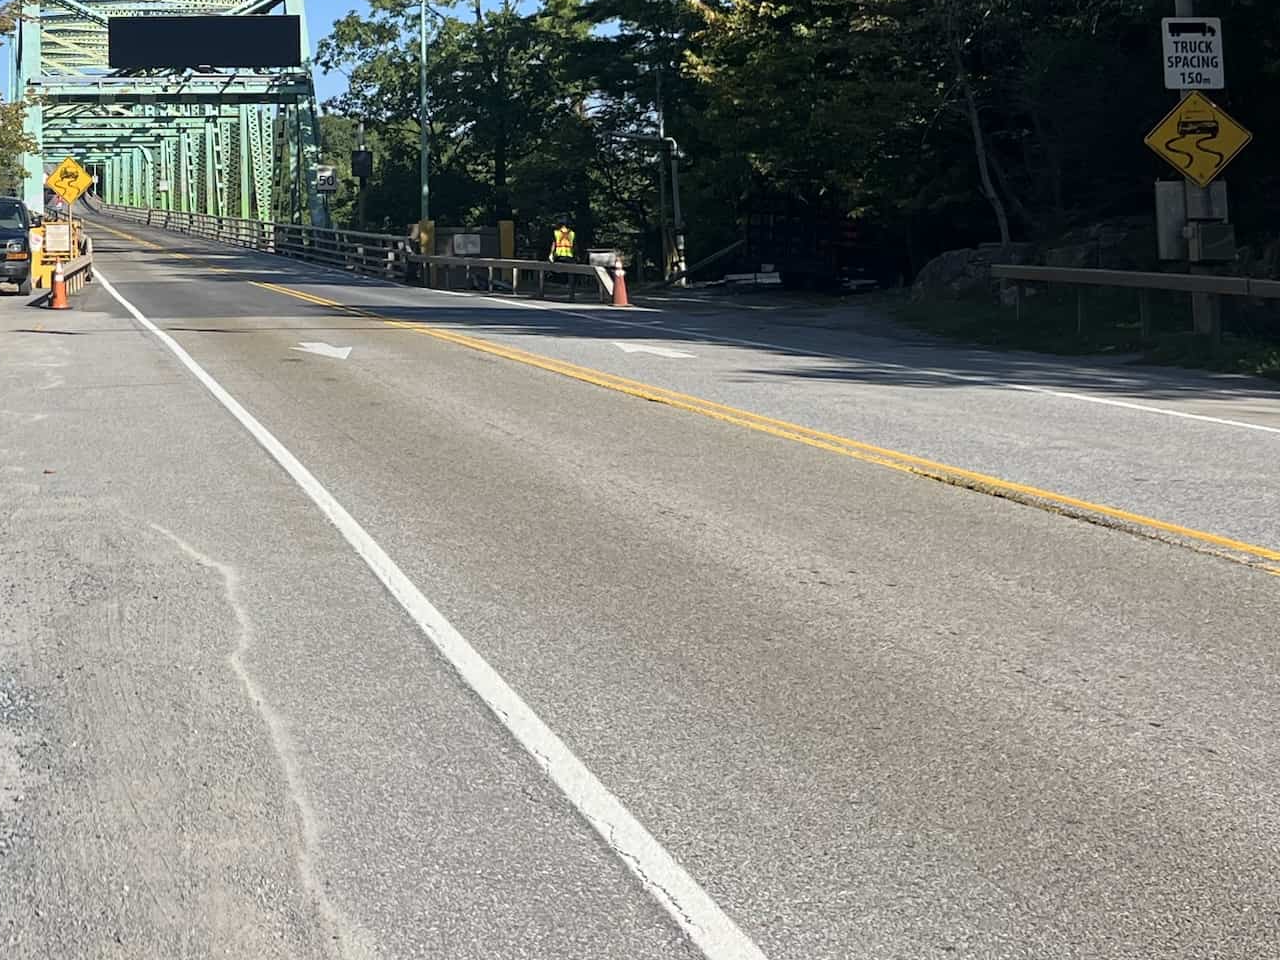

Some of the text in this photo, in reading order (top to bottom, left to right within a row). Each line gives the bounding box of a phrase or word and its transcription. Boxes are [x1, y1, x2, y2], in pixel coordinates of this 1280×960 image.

[1173, 40, 1213, 53] TRUCK
[1168, 55, 1219, 69] SPACING
[319, 175, 335, 186] 50
